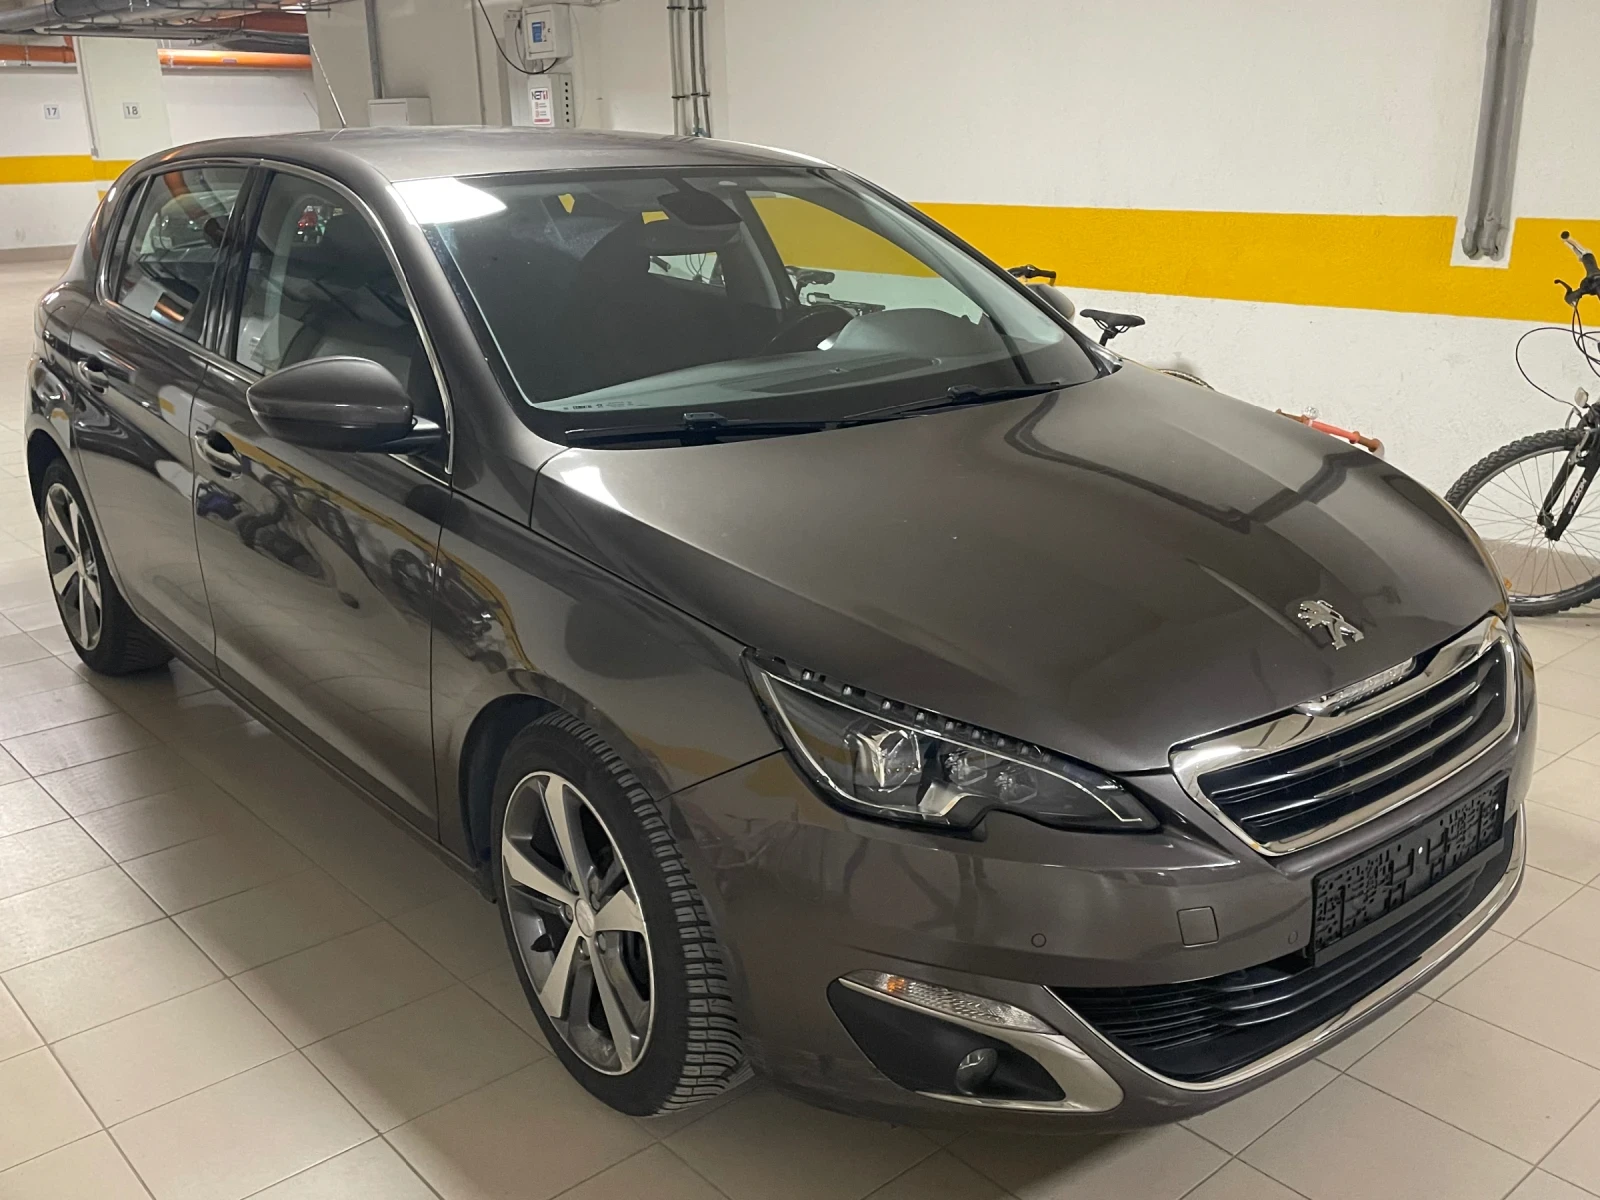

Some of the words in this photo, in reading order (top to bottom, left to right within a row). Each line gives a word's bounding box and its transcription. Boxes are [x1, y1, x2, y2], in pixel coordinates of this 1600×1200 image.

[46, 107, 57, 116] 17
[126, 106, 139, 115] 18
[1571, 478, 1587, 506] ZOOM
